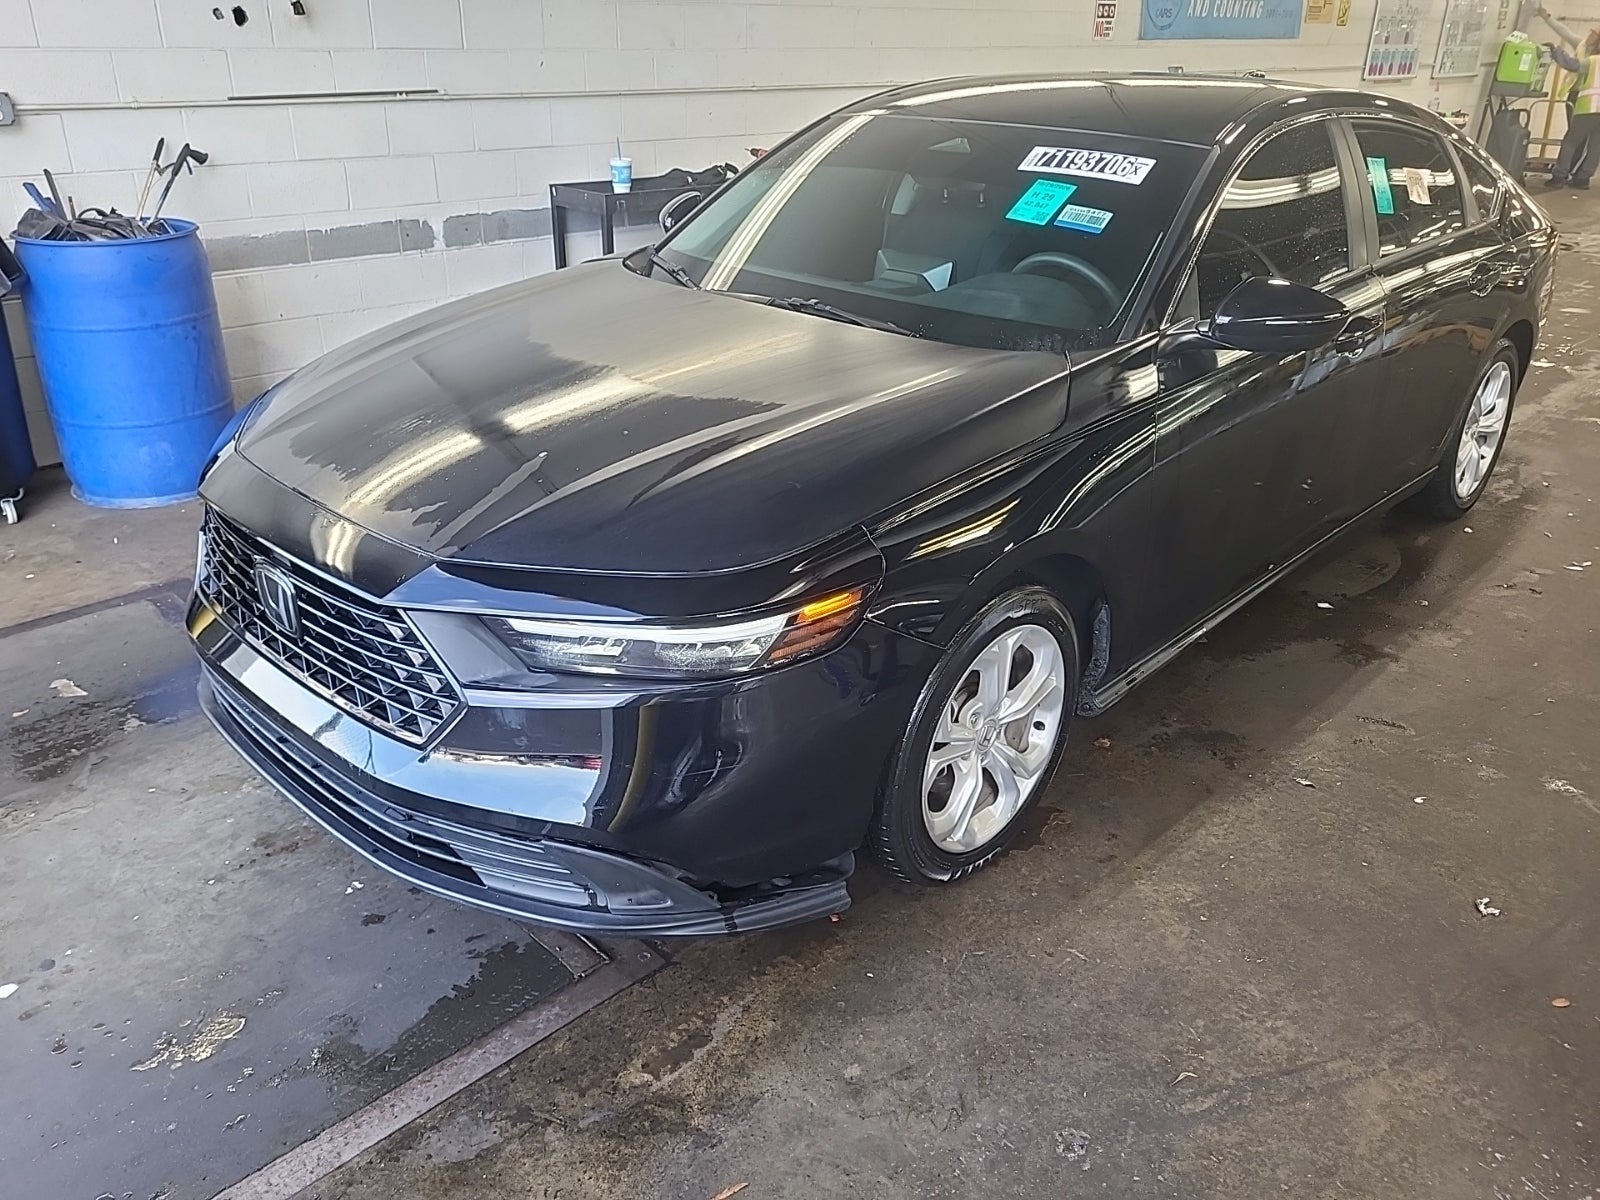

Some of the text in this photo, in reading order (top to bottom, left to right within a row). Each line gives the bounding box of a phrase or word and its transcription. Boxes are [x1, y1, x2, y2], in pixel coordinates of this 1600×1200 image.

[1187, 0, 1211, 17] AND
[1212, 0, 1264, 19] COUNTING
[1033, 148, 1137, 177] 71193706
[1031, 191, 1042, 199] H
